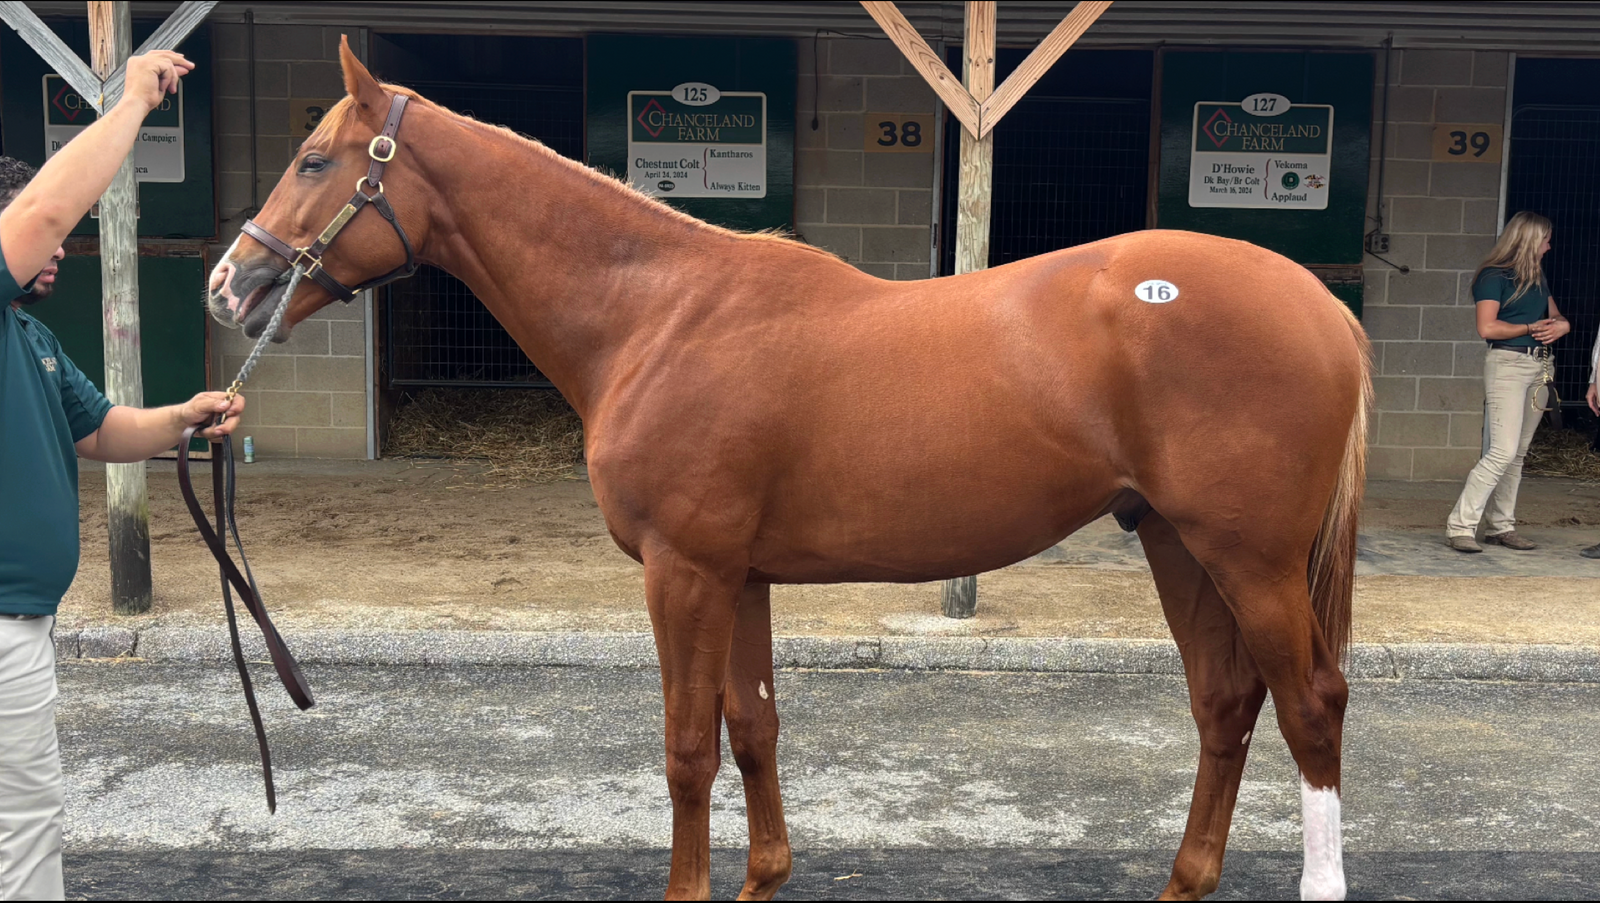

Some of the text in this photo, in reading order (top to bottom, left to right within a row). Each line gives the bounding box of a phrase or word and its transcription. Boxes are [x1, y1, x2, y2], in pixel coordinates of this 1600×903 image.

[683, 87, 708, 102] 125
[1252, 98, 1277, 112] 127
[648, 110, 755, 128] CHANCELAND
[678, 127, 720, 141] FARM
[877, 121, 922, 147] 38
[1213, 120, 1321, 138] CHANCELAND
[141, 132, 177, 144] Campaign
[1242, 137, 1285, 150] FARM
[1447, 131, 1490, 158] 39
[709, 149, 753, 159] Kantharos
[635, 158, 700, 169] Chestnut Colt
[1212, 163, 1255, 174] D'Howie
[1274, 160, 1308, 169] Vekoma
[644, 171, 688, 179] April 24, 2024
[1204, 176, 1260, 186] Dk Bay/Br Colt
[710, 182, 761, 192] Always Kitten
[1209, 186, 1228, 194] March
[1271, 192, 1308, 202] Applaud
[1142, 285, 1171, 301] 16
